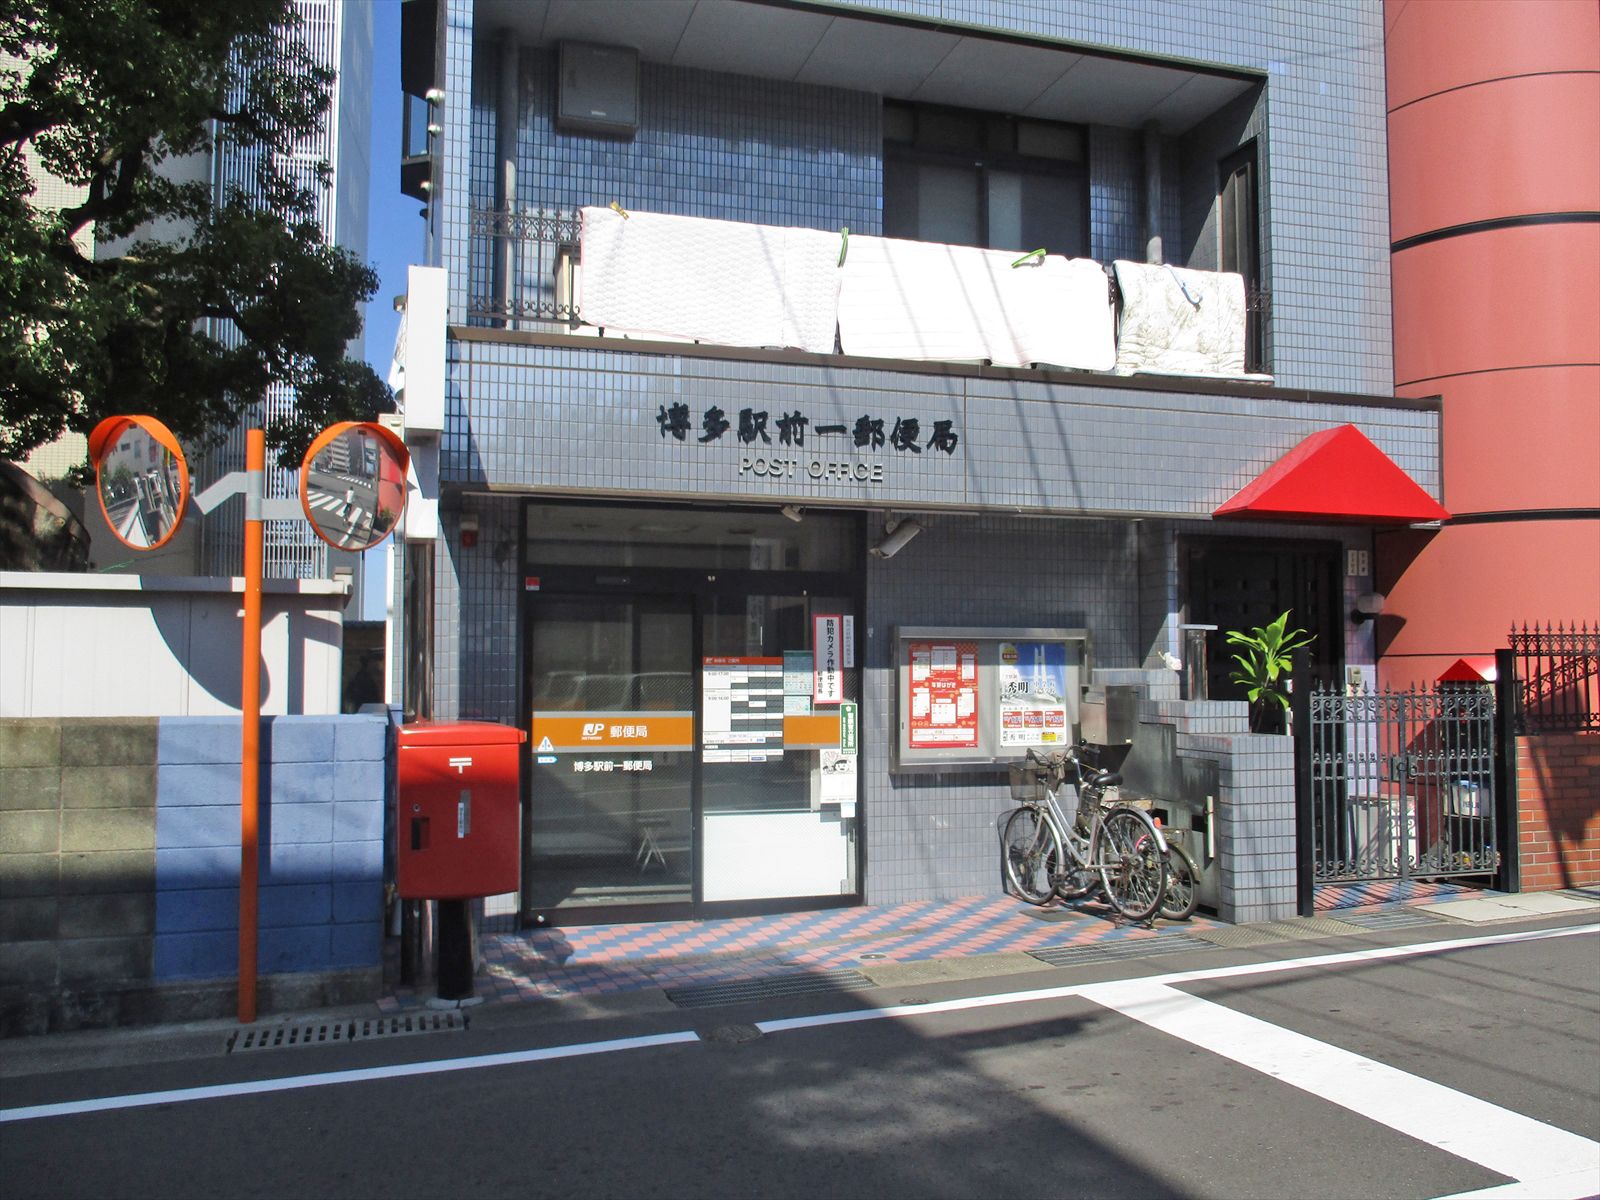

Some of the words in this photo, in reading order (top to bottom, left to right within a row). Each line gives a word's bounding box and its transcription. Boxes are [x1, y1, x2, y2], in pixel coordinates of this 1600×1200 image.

[656, 401, 958, 455] 博多駅前一郵便局
[738, 457, 797, 477] POST
[807, 459, 884, 482] OFFICE
[827, 619, 835, 698] 防犯カメラ作動中です
[1008, 681, 1029, 693] 秀明
[610, 725, 648, 738] 郵便局
[573, 760, 653, 772] 博多駅前一郵便局
